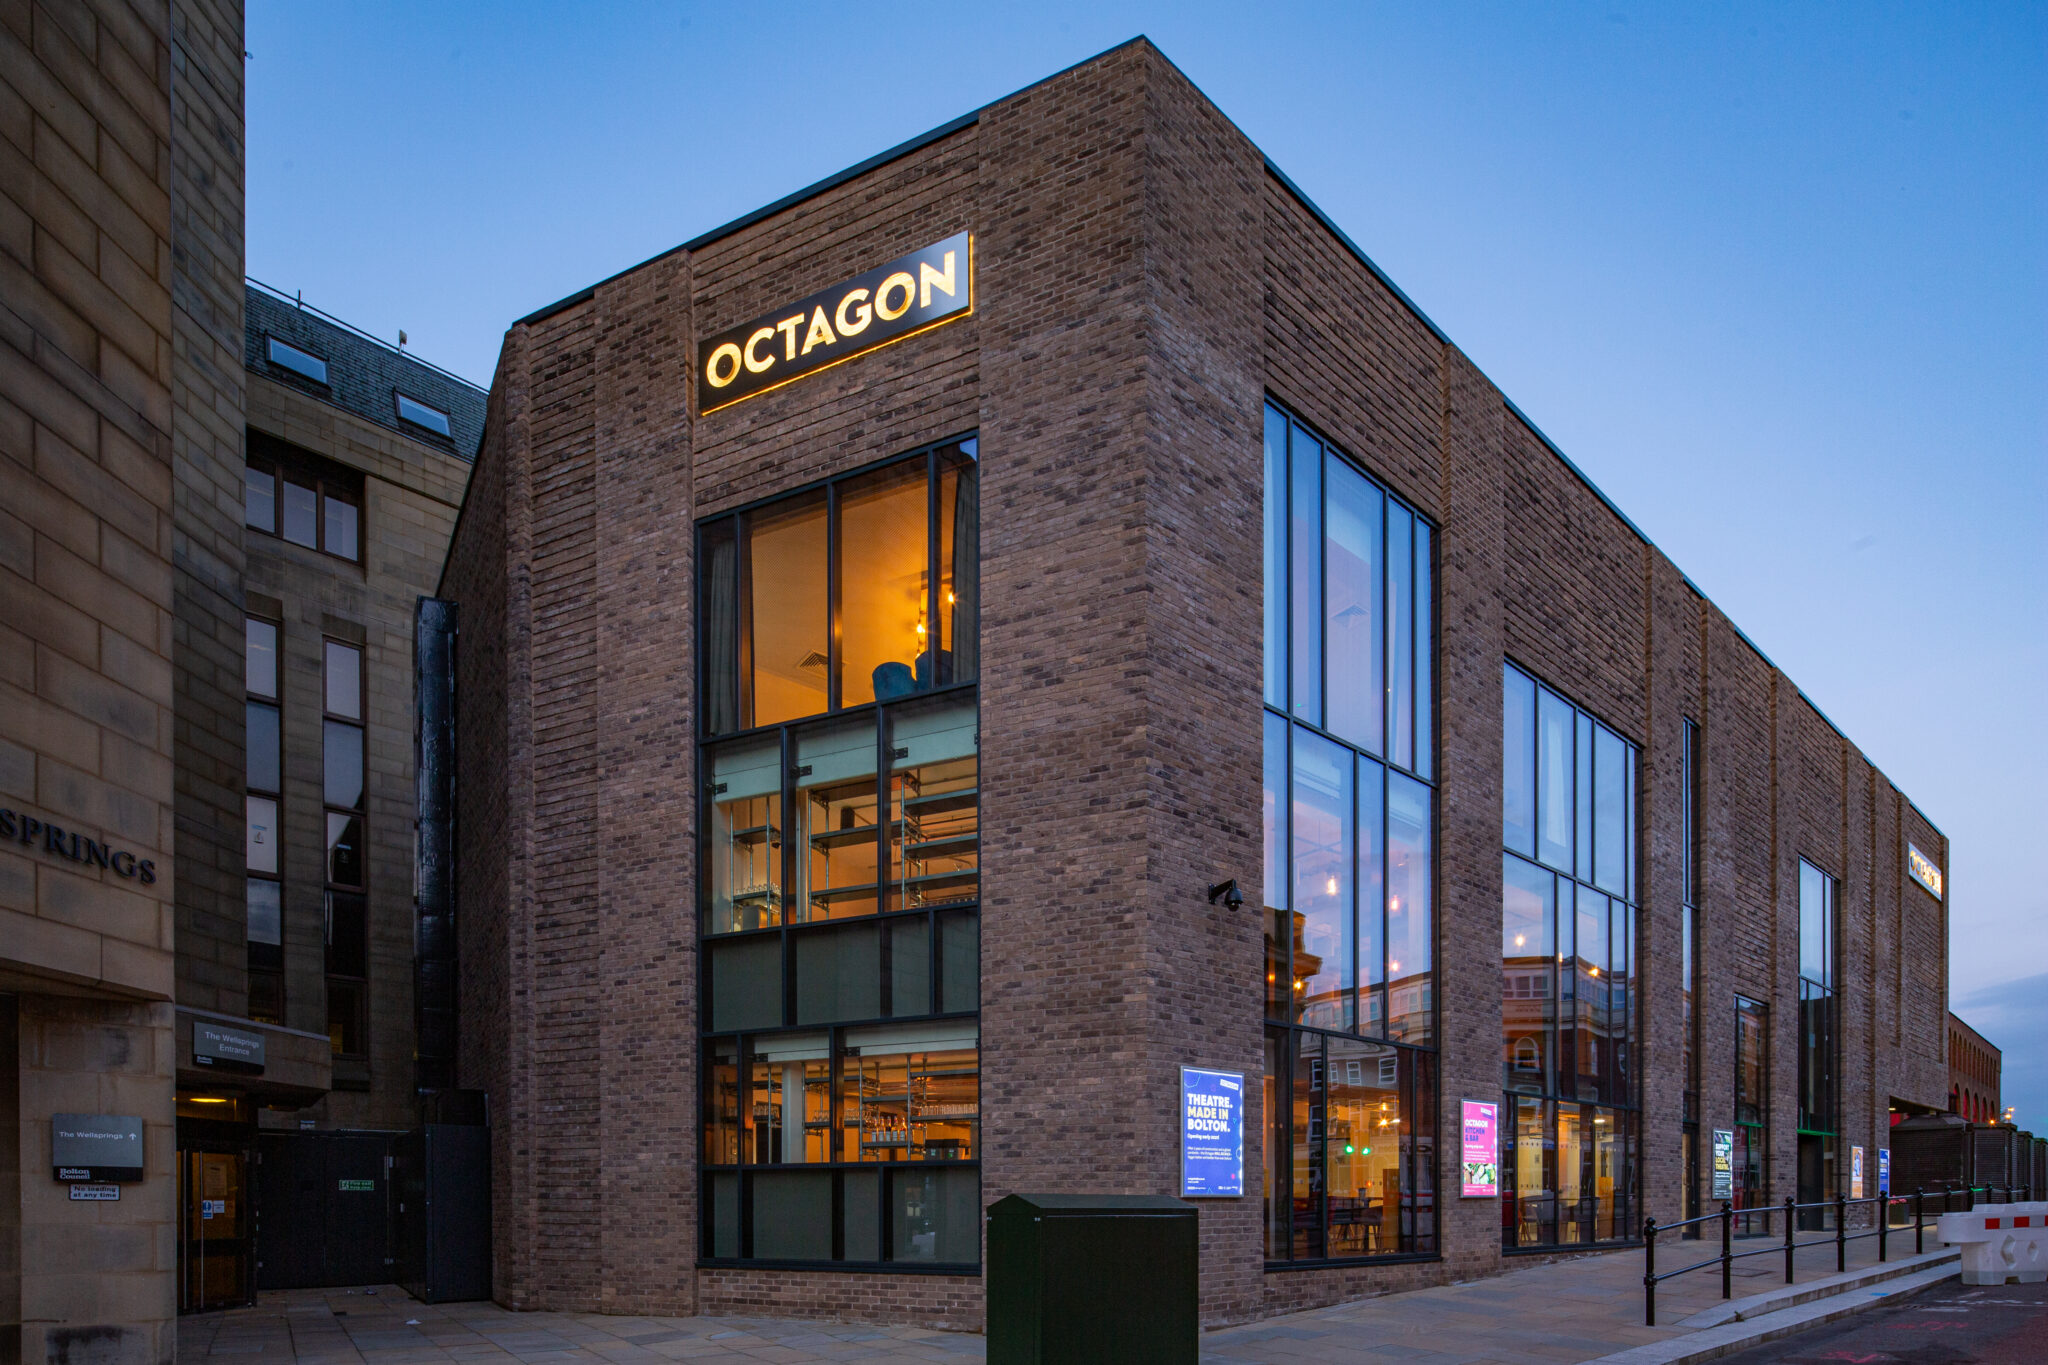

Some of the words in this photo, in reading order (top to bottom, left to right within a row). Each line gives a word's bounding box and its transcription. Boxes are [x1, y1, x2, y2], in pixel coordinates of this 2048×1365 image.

[706, 250, 956, 388] OCTAGON
[0, 808, 156, 884] SPRINGS
[1910, 850, 1942, 895] OCTAGON
[205, 1031, 220, 1040] The
[222, 1034, 260, 1049] Wellsprings
[219, 1043, 250, 1056] Entrance
[1187, 1093, 1233, 1108] THEATRE.
[1187, 1105, 1217, 1119] MADE
[1218, 1108, 1229, 1120] IN
[1187, 1118, 1231, 1132] BOLTON.
[1465, 1119, 1488, 1128] OCTAGON
[76, 1131, 124, 1140] Wellsprings
